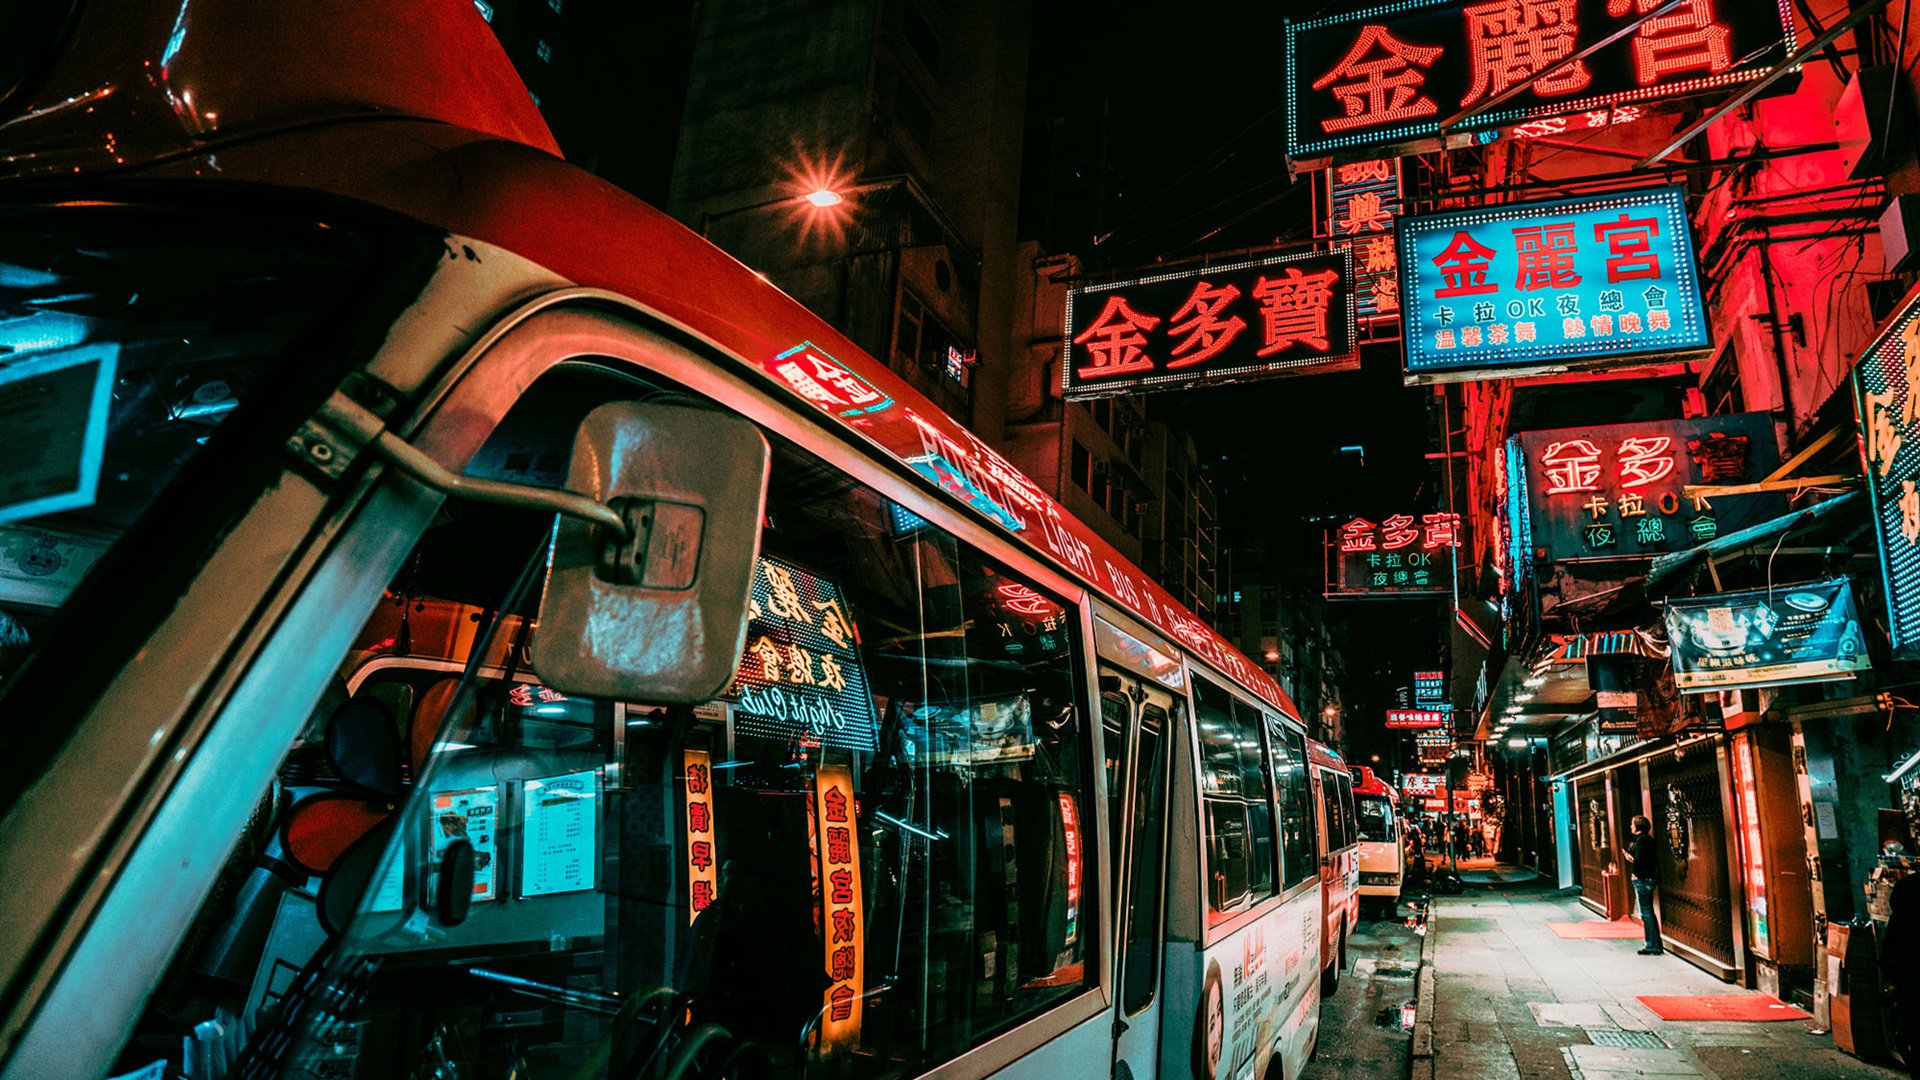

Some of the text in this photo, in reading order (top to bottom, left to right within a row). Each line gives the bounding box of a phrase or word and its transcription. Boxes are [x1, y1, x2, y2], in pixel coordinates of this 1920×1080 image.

[1432, 213, 1661, 299] 金麗宮
[1073, 267, 1339, 379] 金多寶
[1341, 512, 1461, 552] 金多寶
[1366, 552, 1432, 568] 卡拉OK
[1586, 515, 1718, 547] 夜總會
[1037, 509, 1099, 581] LIGHT
[1104, 560, 1142, 611] BUS
[1142, 588, 1162, 625] 16
